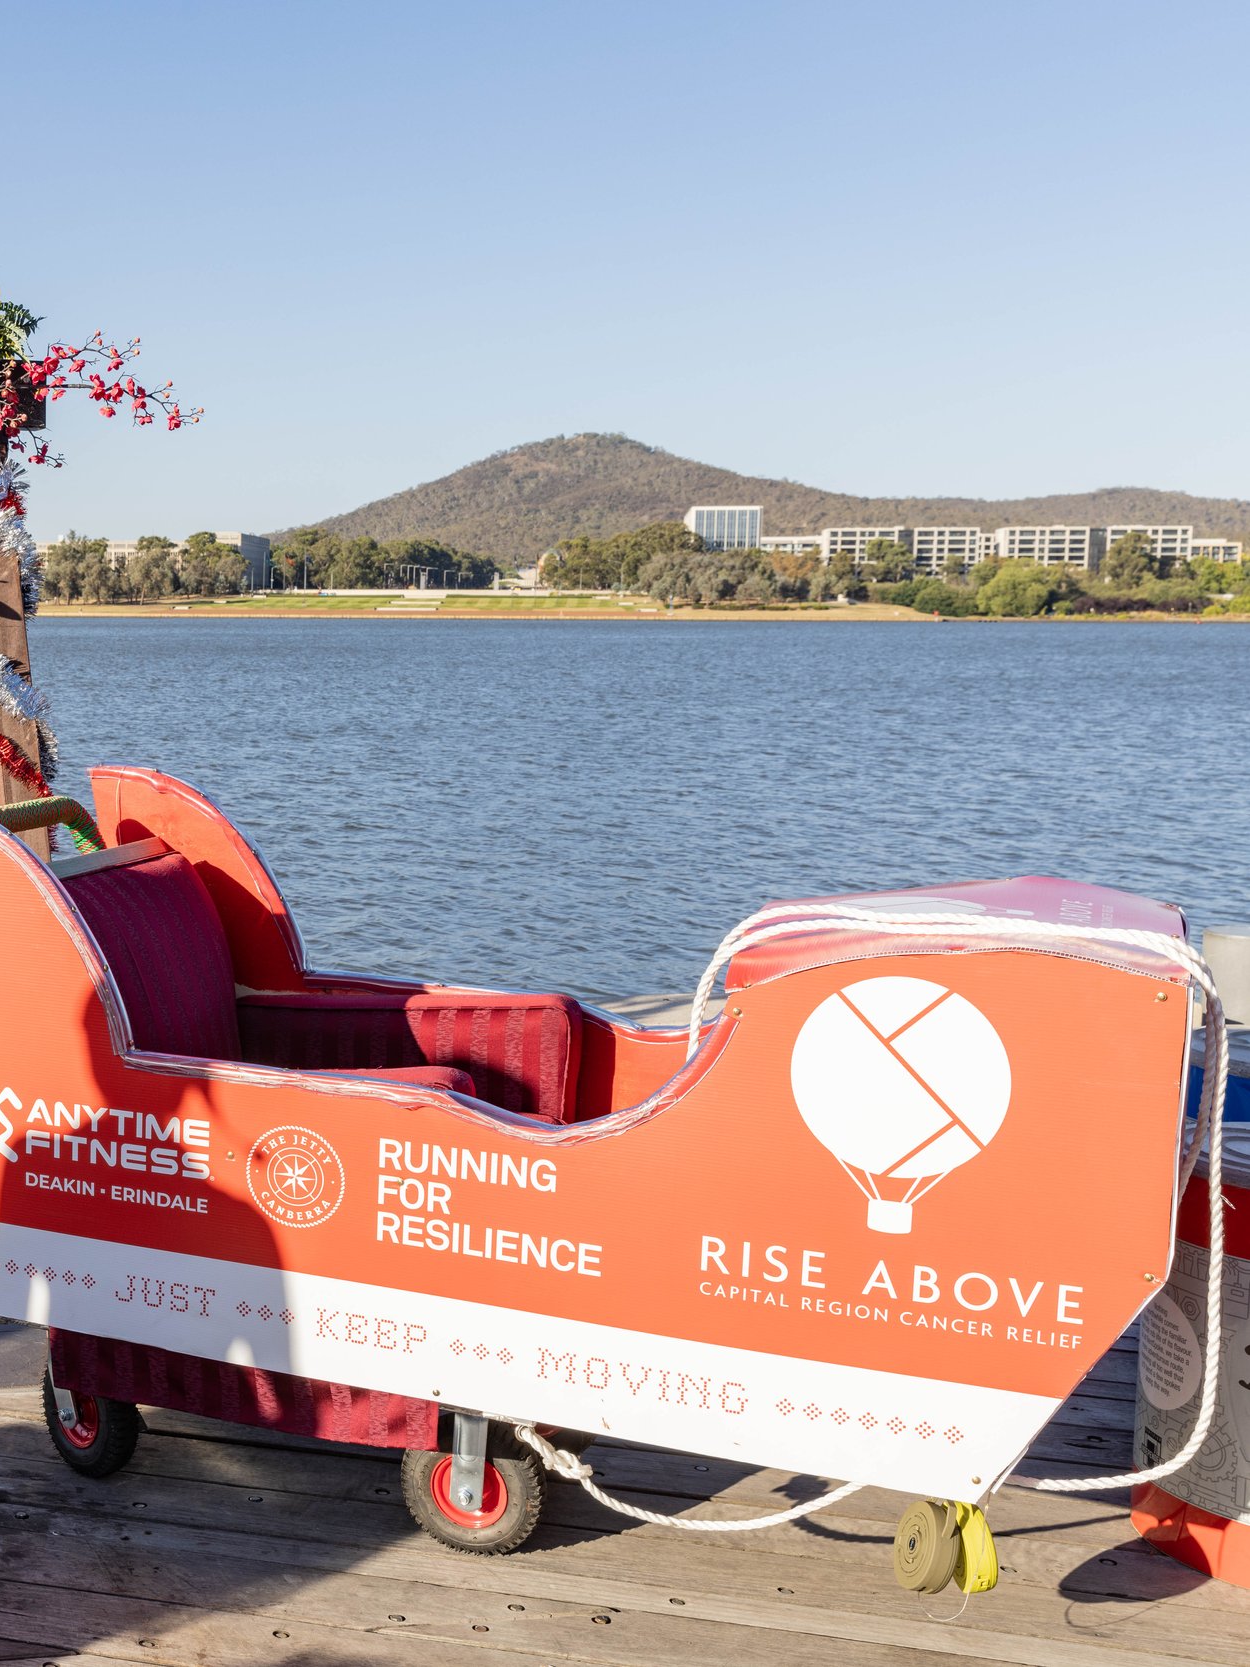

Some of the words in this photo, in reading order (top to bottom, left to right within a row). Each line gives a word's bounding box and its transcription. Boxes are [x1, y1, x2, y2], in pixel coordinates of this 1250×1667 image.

[26, 1098, 210, 1147] ANYTIME
[25, 1130, 211, 1181] FITNESS
[261, 1135, 287, 1155] THE
[292, 1134, 333, 1165] JETTY
[377, 1137, 558, 1194] RUNNING
[25, 1171, 95, 1197] DEAKIN
[110, 1185, 209, 1214] ERINDALE
[260, 1190, 331, 1221] CANBERRA
[377, 1174, 453, 1215] FOR
[376, 1211, 604, 1278] RESILIENCE
[699, 1235, 827, 1289] RISE
[861, 1259, 1085, 1325] ABOVE
[698, 1281, 790, 1309] CAPITAL
[800, 1296, 889, 1323] REGION
[898, 1310, 994, 1338] CANCER
[1006, 1325, 1084, 1351] RELIEF
[1164, 1319, 1179, 1332] comes
[114, 1274, 216, 1317] JUST
[316, 1307, 428, 1353] KEEP
[536, 1347, 750, 1415] MOVING
[1169, 1330, 1187, 1346] familiar
[1174, 1342, 1192, 1359] flavour.
[1164, 1367, 1173, 1378] well
[1174, 1371, 1184, 1384] that
[1174, 1352, 1184, 1365] take
[1186, 1358, 1189, 1367] a
